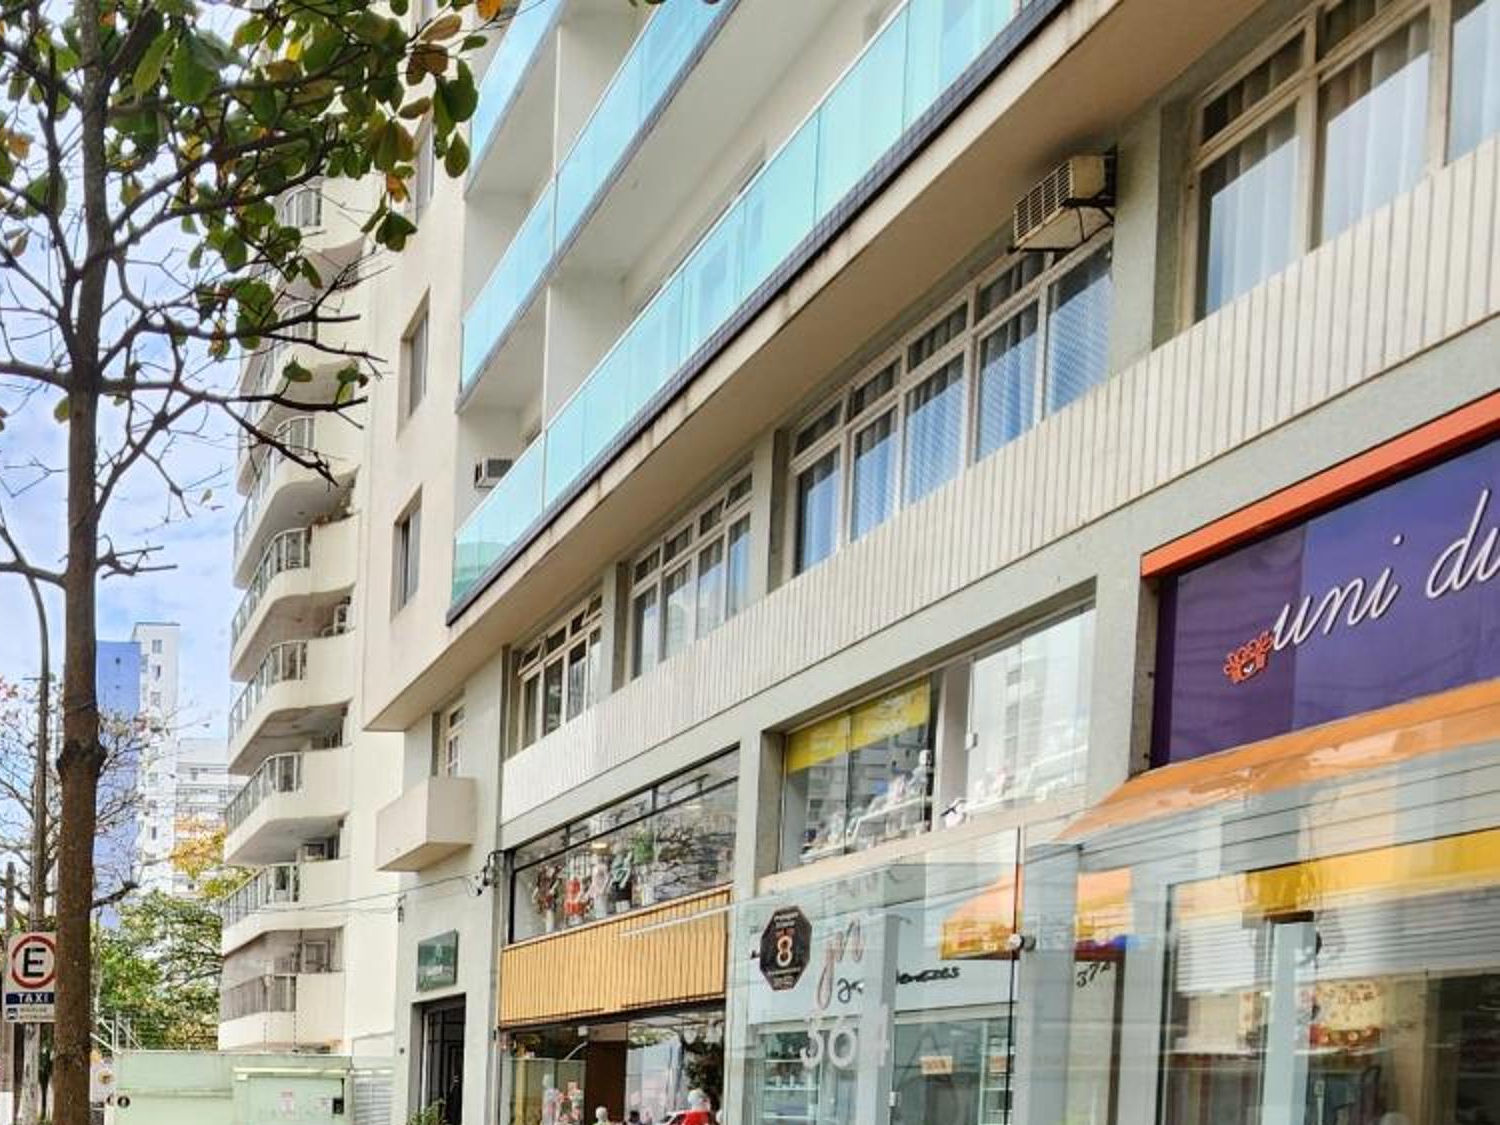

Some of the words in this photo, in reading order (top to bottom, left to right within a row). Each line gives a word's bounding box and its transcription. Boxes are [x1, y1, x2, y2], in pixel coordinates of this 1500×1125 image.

[1273, 534, 1402, 650] uni
[23, 948, 46, 977] E
[18, 992, 50, 1003] TAXI
